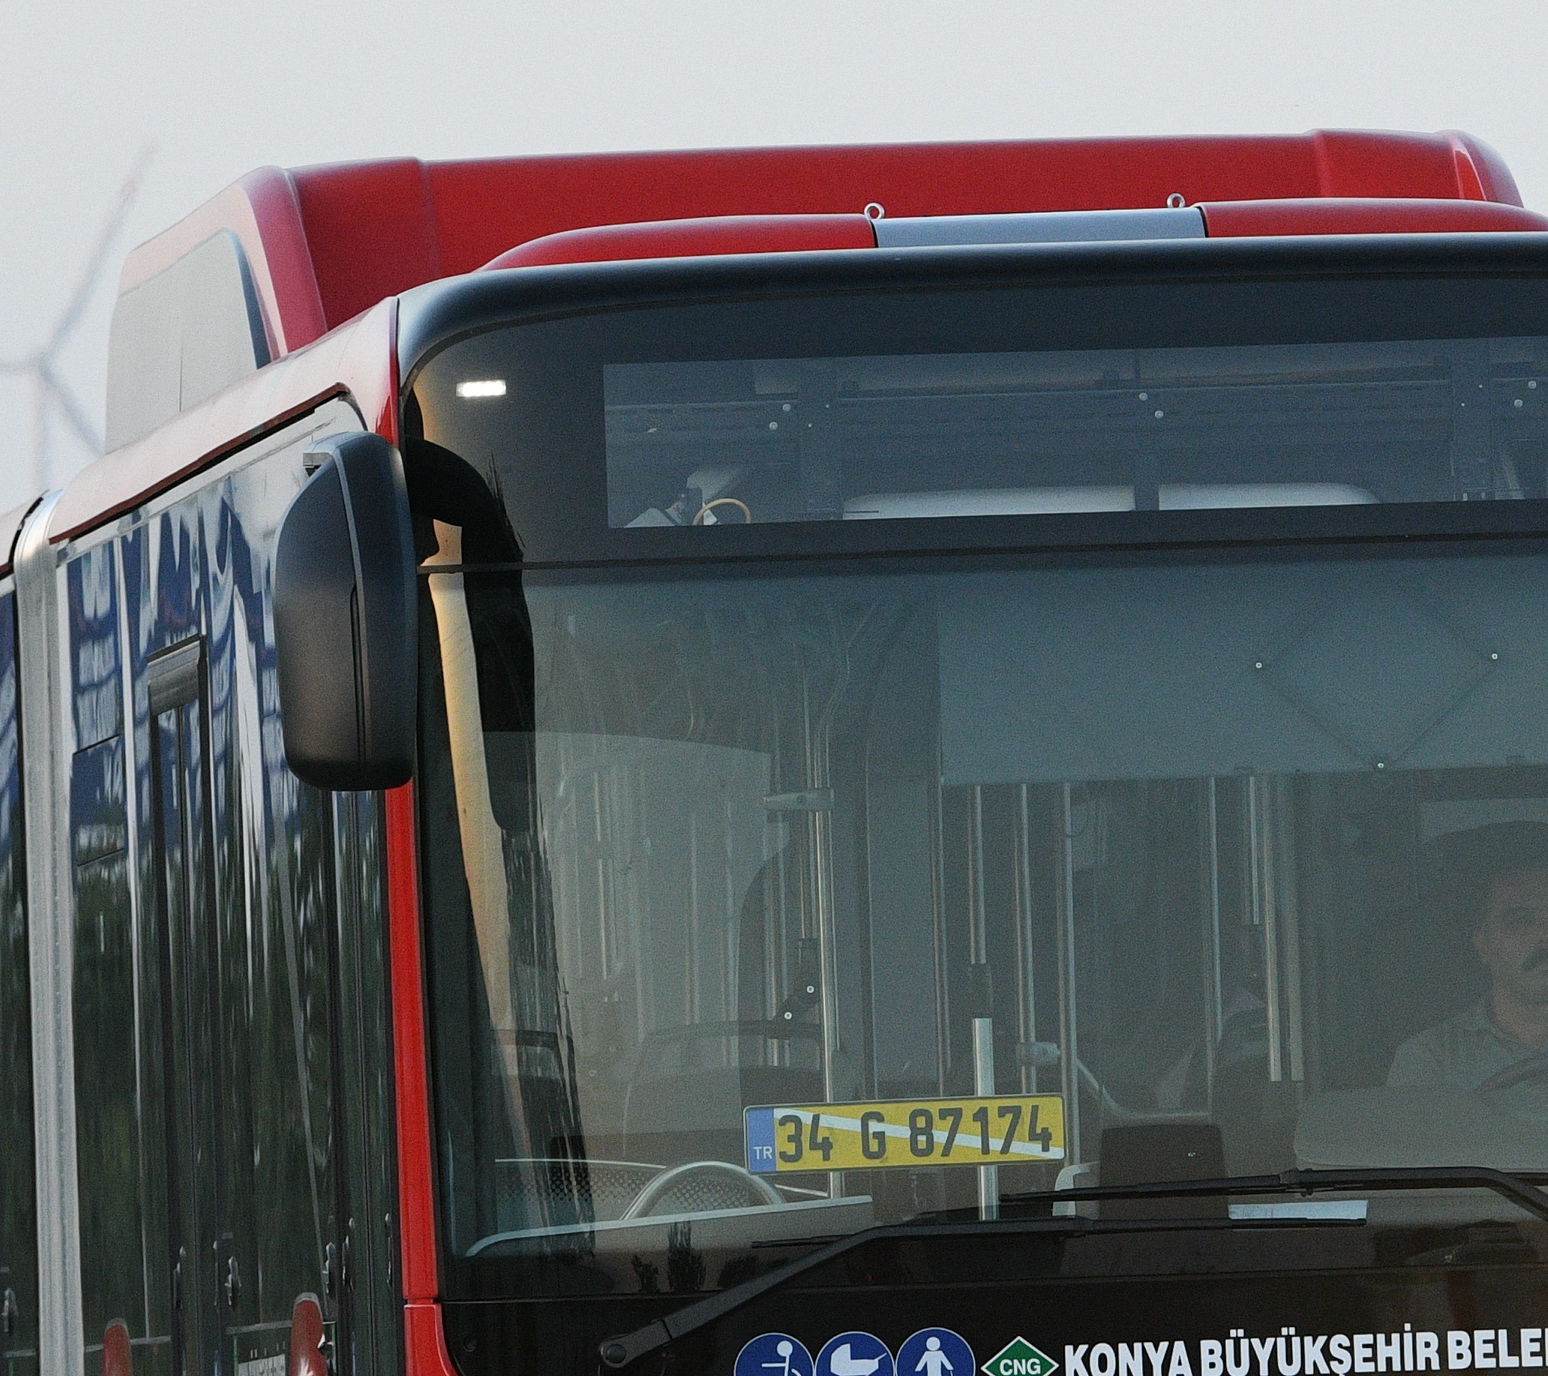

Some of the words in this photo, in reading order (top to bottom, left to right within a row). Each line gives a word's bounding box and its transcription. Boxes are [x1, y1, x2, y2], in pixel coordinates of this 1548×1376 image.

[778, 1113, 834, 1163] 34
[860, 1111, 886, 1160] G
[909, 1104, 1052, 1158] 87174
[753, 1145, 773, 1160] TR
[999, 1357, 1041, 1376] CNG
